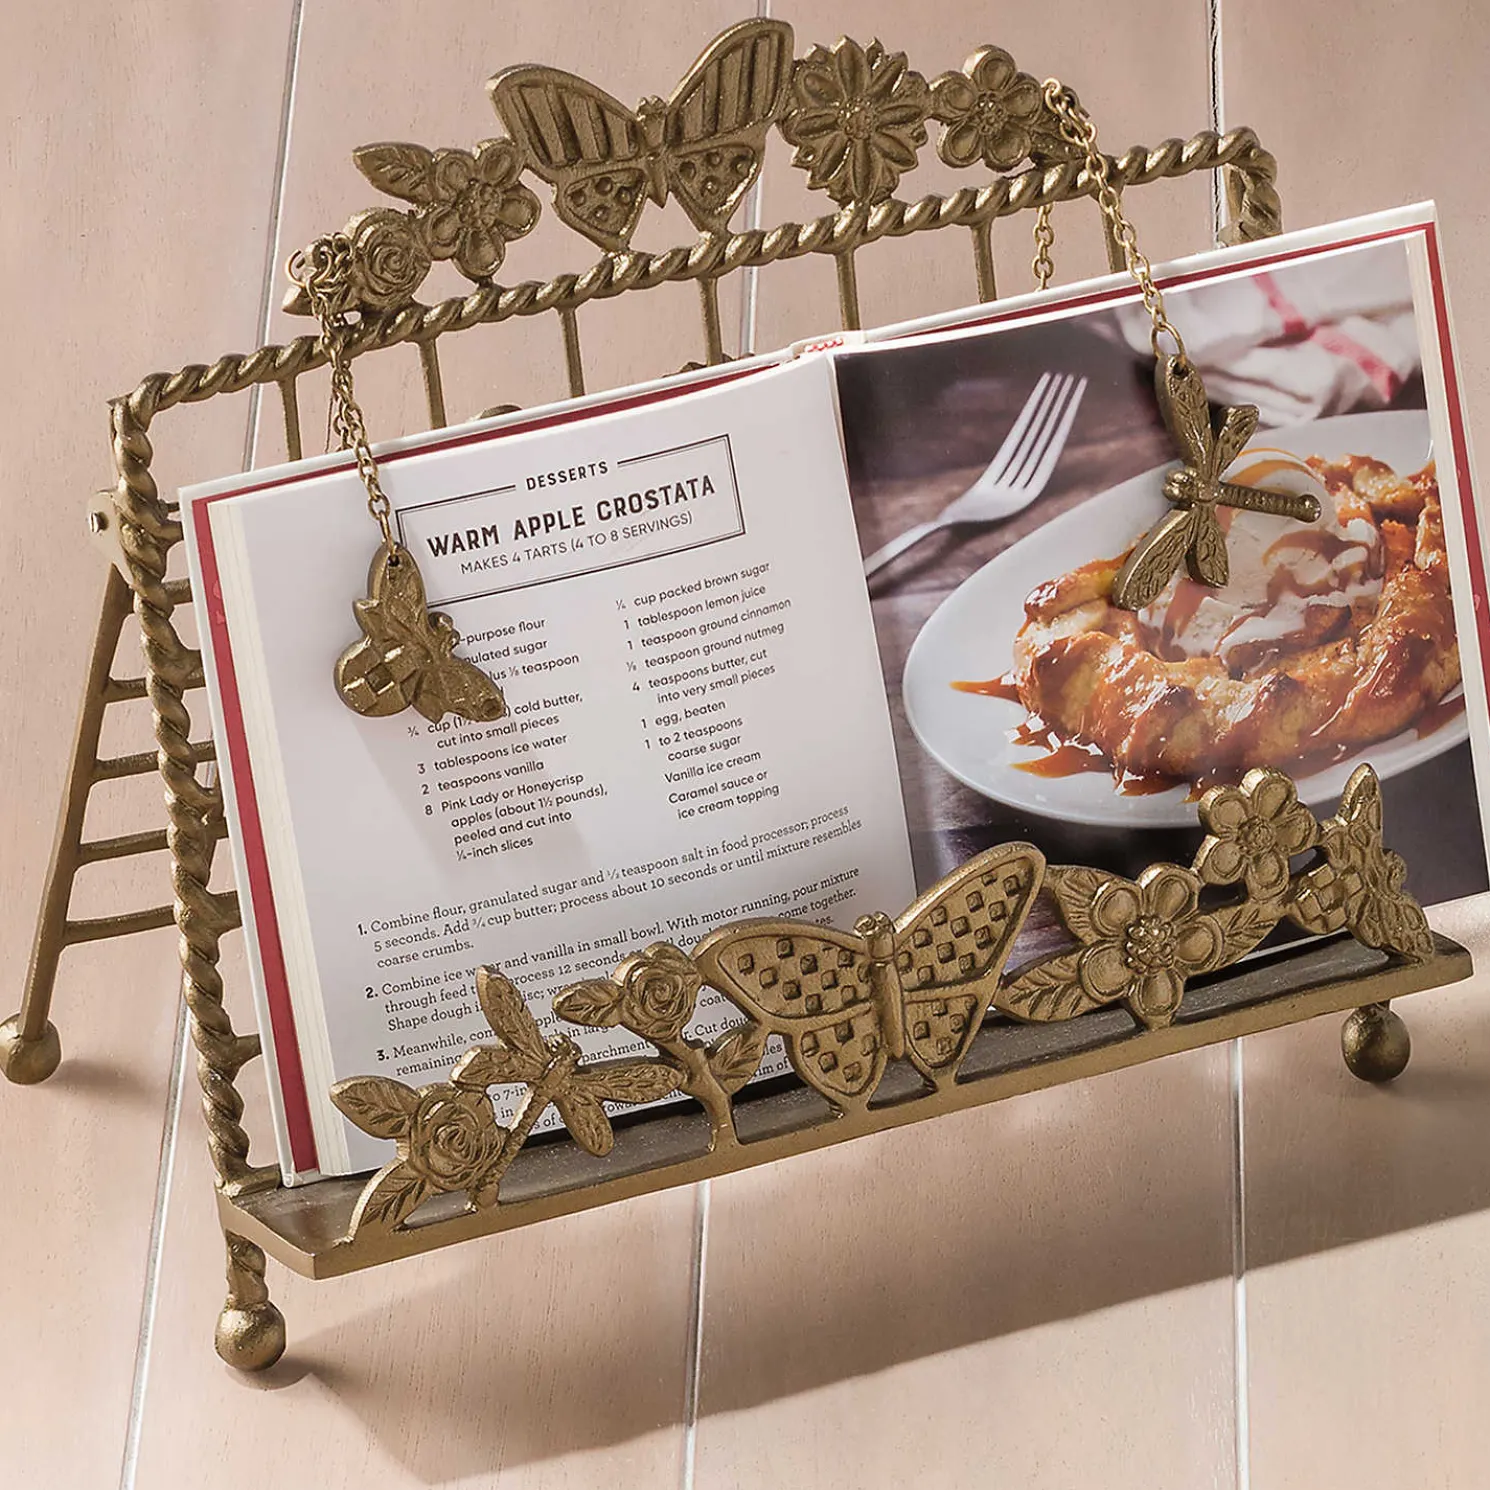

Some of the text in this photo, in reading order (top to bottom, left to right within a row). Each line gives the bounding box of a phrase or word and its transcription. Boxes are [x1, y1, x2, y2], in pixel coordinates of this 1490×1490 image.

[525, 460, 608, 491] DESSERTS
[426, 474, 715, 558] WARM APPLE CROSTATA
[460, 511, 693, 575] MAKES 4 TARTS (4 TO 8 SERVINGS)
[633, 562, 770, 607] cup packed brown sugar
[623, 585, 766, 630] 1 tablespoon lemon juice
[626, 598, 792, 650] 1 teaspoon ground cinnamon
[459, 619, 546, 646] -purpose flour
[512, 640, 548, 656] sugar
[644, 622, 785, 669] teaspoon ground nutmeg
[521, 654, 580, 675] teaspoon
[631, 648, 768, 692] 4 teaspoons butter, cut
[656, 664, 776, 704] into very small pieces
[513, 699, 541, 715] cold
[542, 692, 583, 709] butter,
[640, 700, 726, 729] 1 egg, beaten
[426, 717, 451, 734] cup
[436, 715, 560, 749] cut into small pieces
[643, 717, 744, 750] 1 to 2 teaspoons
[416, 734, 567, 775] 3 tablespoons ice water
[667, 735, 741, 762] coarse sugar
[420, 760, 545, 795] 2 teaspoons vanilla
[662, 751, 762, 783] Vanilla ice cream
[424, 774, 584, 816] 8 Pink Lady or Honeycrisp
[667, 770, 768, 804] Caramel sauce or
[676, 784, 780, 820] ice cream topping
[450, 784, 608, 829] apples (about pounds),
[453, 811, 572, 847] peeled and cut into
[500, 836, 534, 852] slices
[357, 805, 849, 936] 1. Combine flour, granulated sugar and teaspoon salt in food processor; process
[373, 819, 862, 953] 5 seconds. Add cup butter; process about 10 seconds or until mixture resembles
[364, 867, 860, 999] 2. Combine ice and vanilla in small bowl. With motor running, pour mixture
[376, 940, 474, 969] coarse crumbs.
[384, 991, 438, 1014] through
[437, 983, 470, 1002] feed
[555, 963, 573, 976] 12
[809, 888, 857, 912] together.
[387, 1015, 428, 1032] Shape
[430, 1002, 474, 1023] dough
[376, 1032, 467, 1062] 3. Meanwhile,
